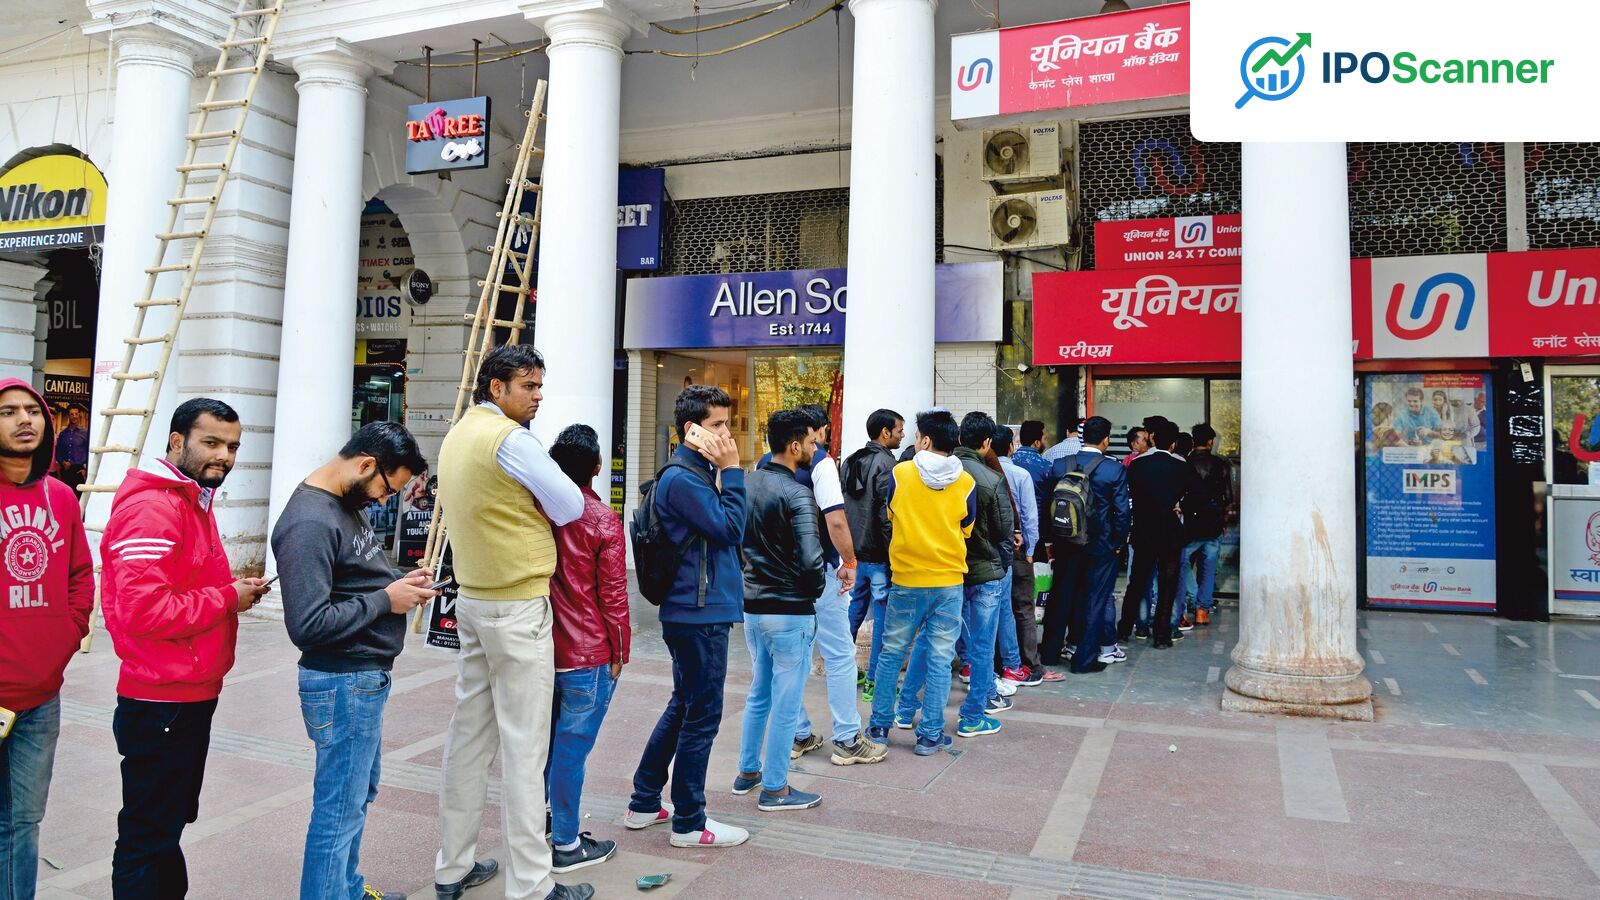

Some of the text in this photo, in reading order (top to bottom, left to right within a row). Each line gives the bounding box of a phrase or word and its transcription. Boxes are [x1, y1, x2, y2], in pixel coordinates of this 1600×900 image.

[1030, 23, 1182, 72] यूनियन बैंक
[1148, 52, 1180, 67] इंडिया
[1088, 72, 1115, 84] शाखा
[0, 184, 90, 222] Nikon
[1040, 194, 1063, 202] VOLTAS
[0, 232, 84, 249] EXPERIENCE ZONE
[1123, 229, 1154, 242] यूनियन
[362, 258, 390, 267] TIMEX
[640, 257, 655, 265] BAR
[1124, 251, 1164, 262] UNION
[1167, 250, 1182, 260] 24
[1186, 249, 1195, 259] X
[1197, 249, 1206, 258] 7
[411, 281, 430, 289] SONY
[1527, 269, 1600, 308] Un
[710, 281, 797, 317] Allen
[1100, 274, 1242, 331] यूनियन
[769, 322, 832, 337] Est 1744
[1532, 334, 1568, 349] कनॉट
[1058, 340, 1114, 359] एटीएम
[45, 379, 90, 395] CANTABIL
[1405, 472, 1450, 488] IMPS
[9, 584, 48, 609] RIJ.
